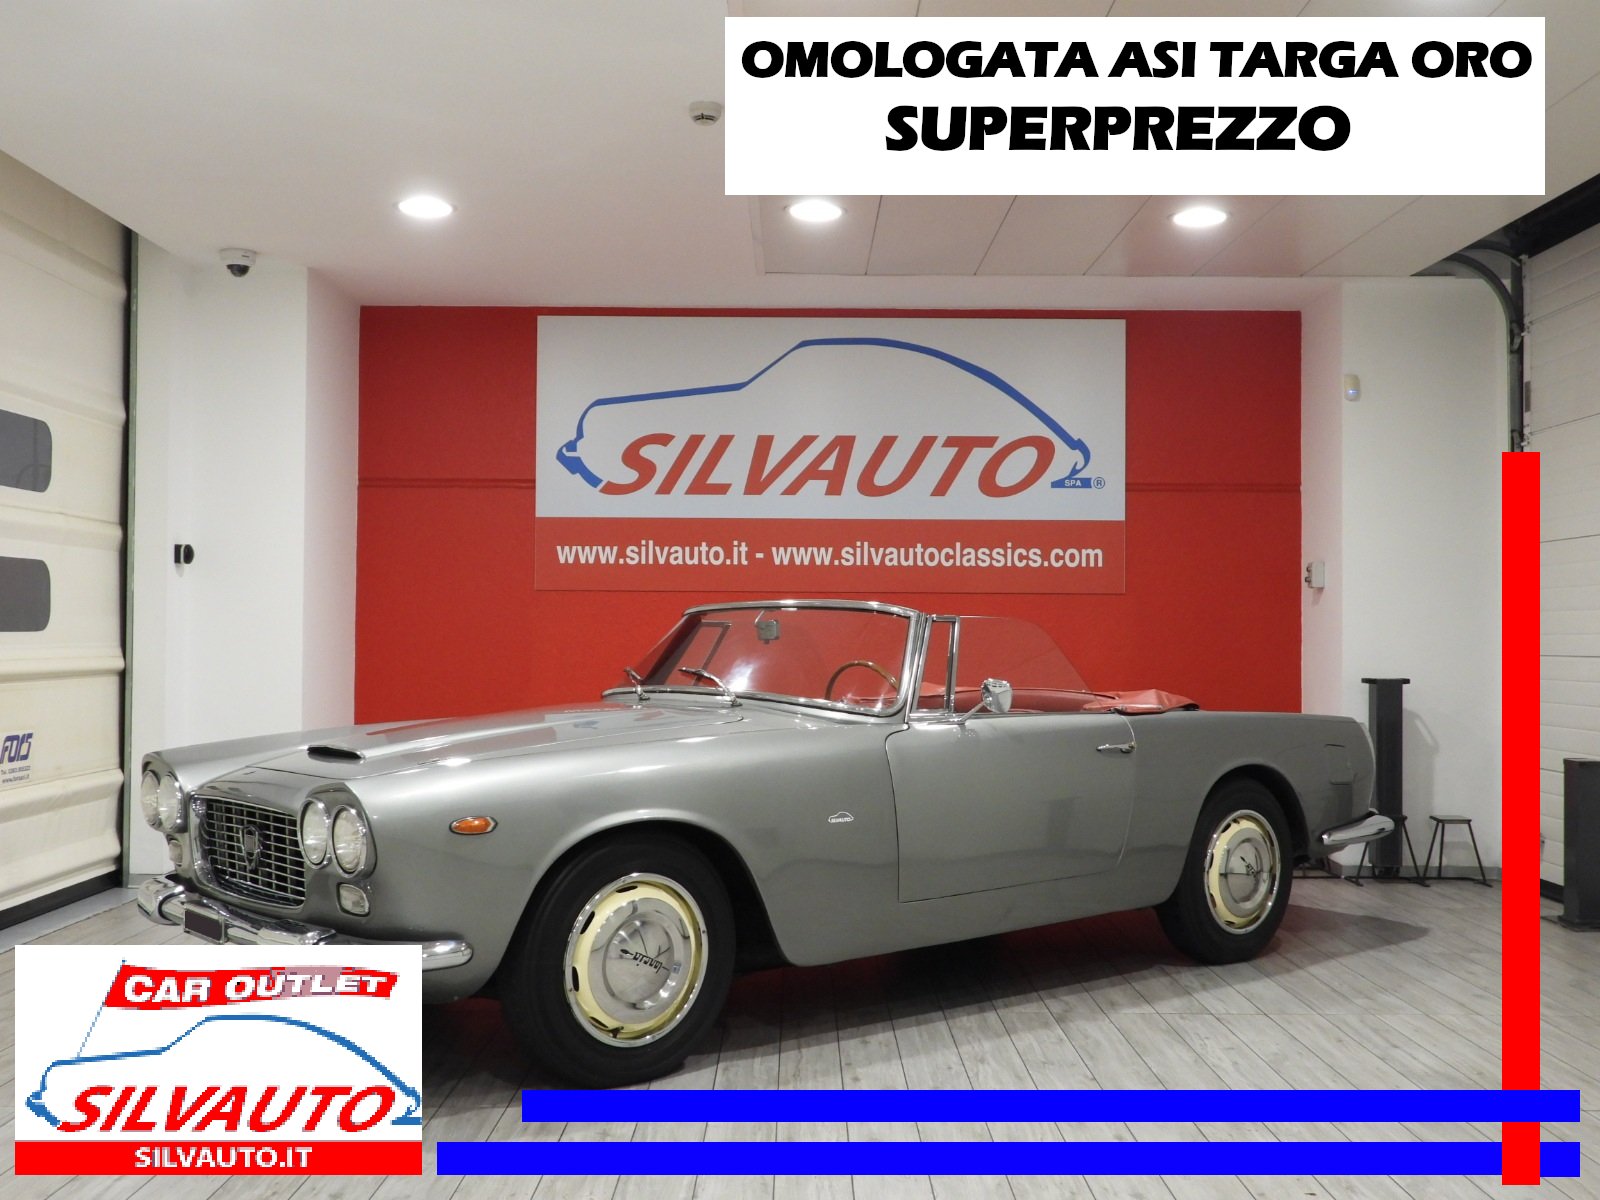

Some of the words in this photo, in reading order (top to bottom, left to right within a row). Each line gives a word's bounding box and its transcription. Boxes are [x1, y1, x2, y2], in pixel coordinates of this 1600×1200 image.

[599, 432, 1056, 498] SILVAUTO
[1064, 479, 1082, 487] SPA
[556, 539, 749, 567] www.silvauto.it
[771, 541, 1104, 569] www.silvautoclassics.com
